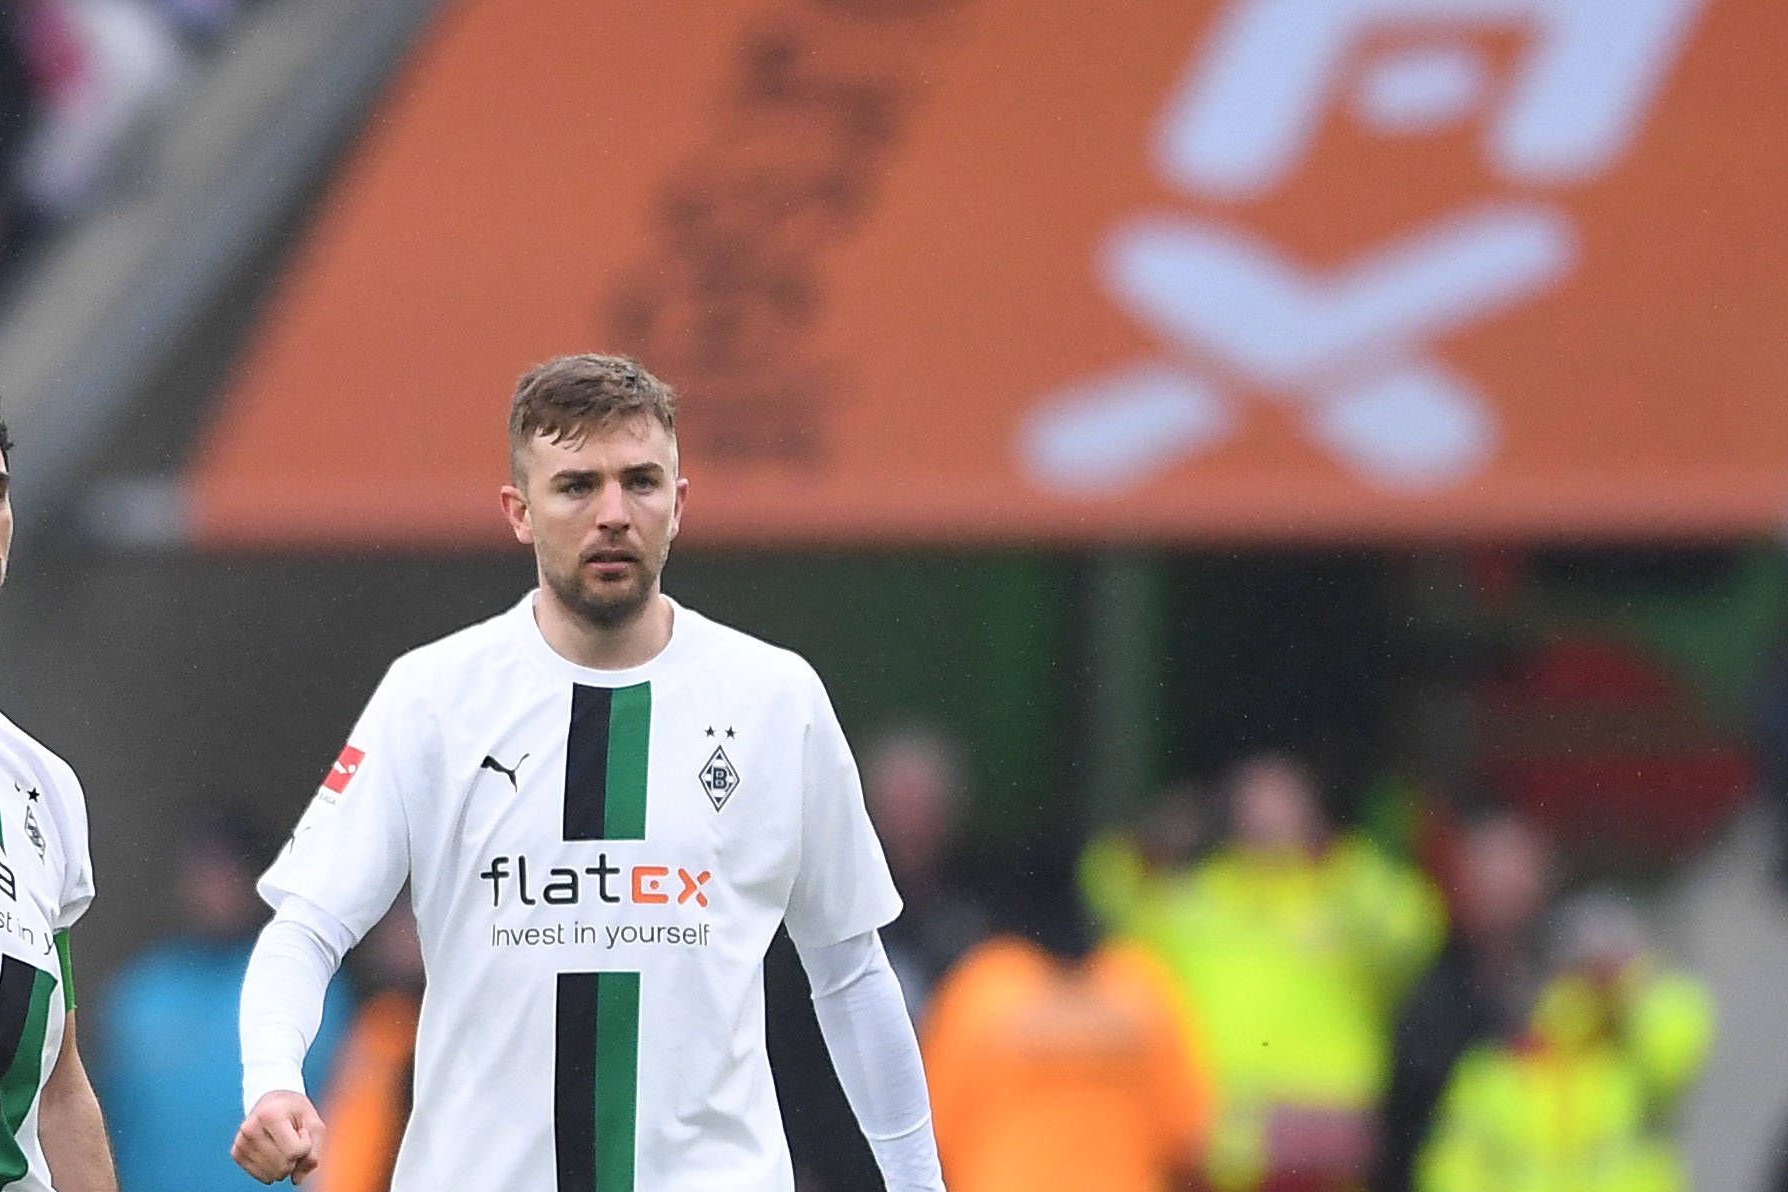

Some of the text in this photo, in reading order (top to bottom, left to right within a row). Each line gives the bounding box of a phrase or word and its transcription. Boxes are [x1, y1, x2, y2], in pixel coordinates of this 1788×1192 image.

[16, 918, 34, 945] in
[492, 921, 711, 949] Invest in yourself
